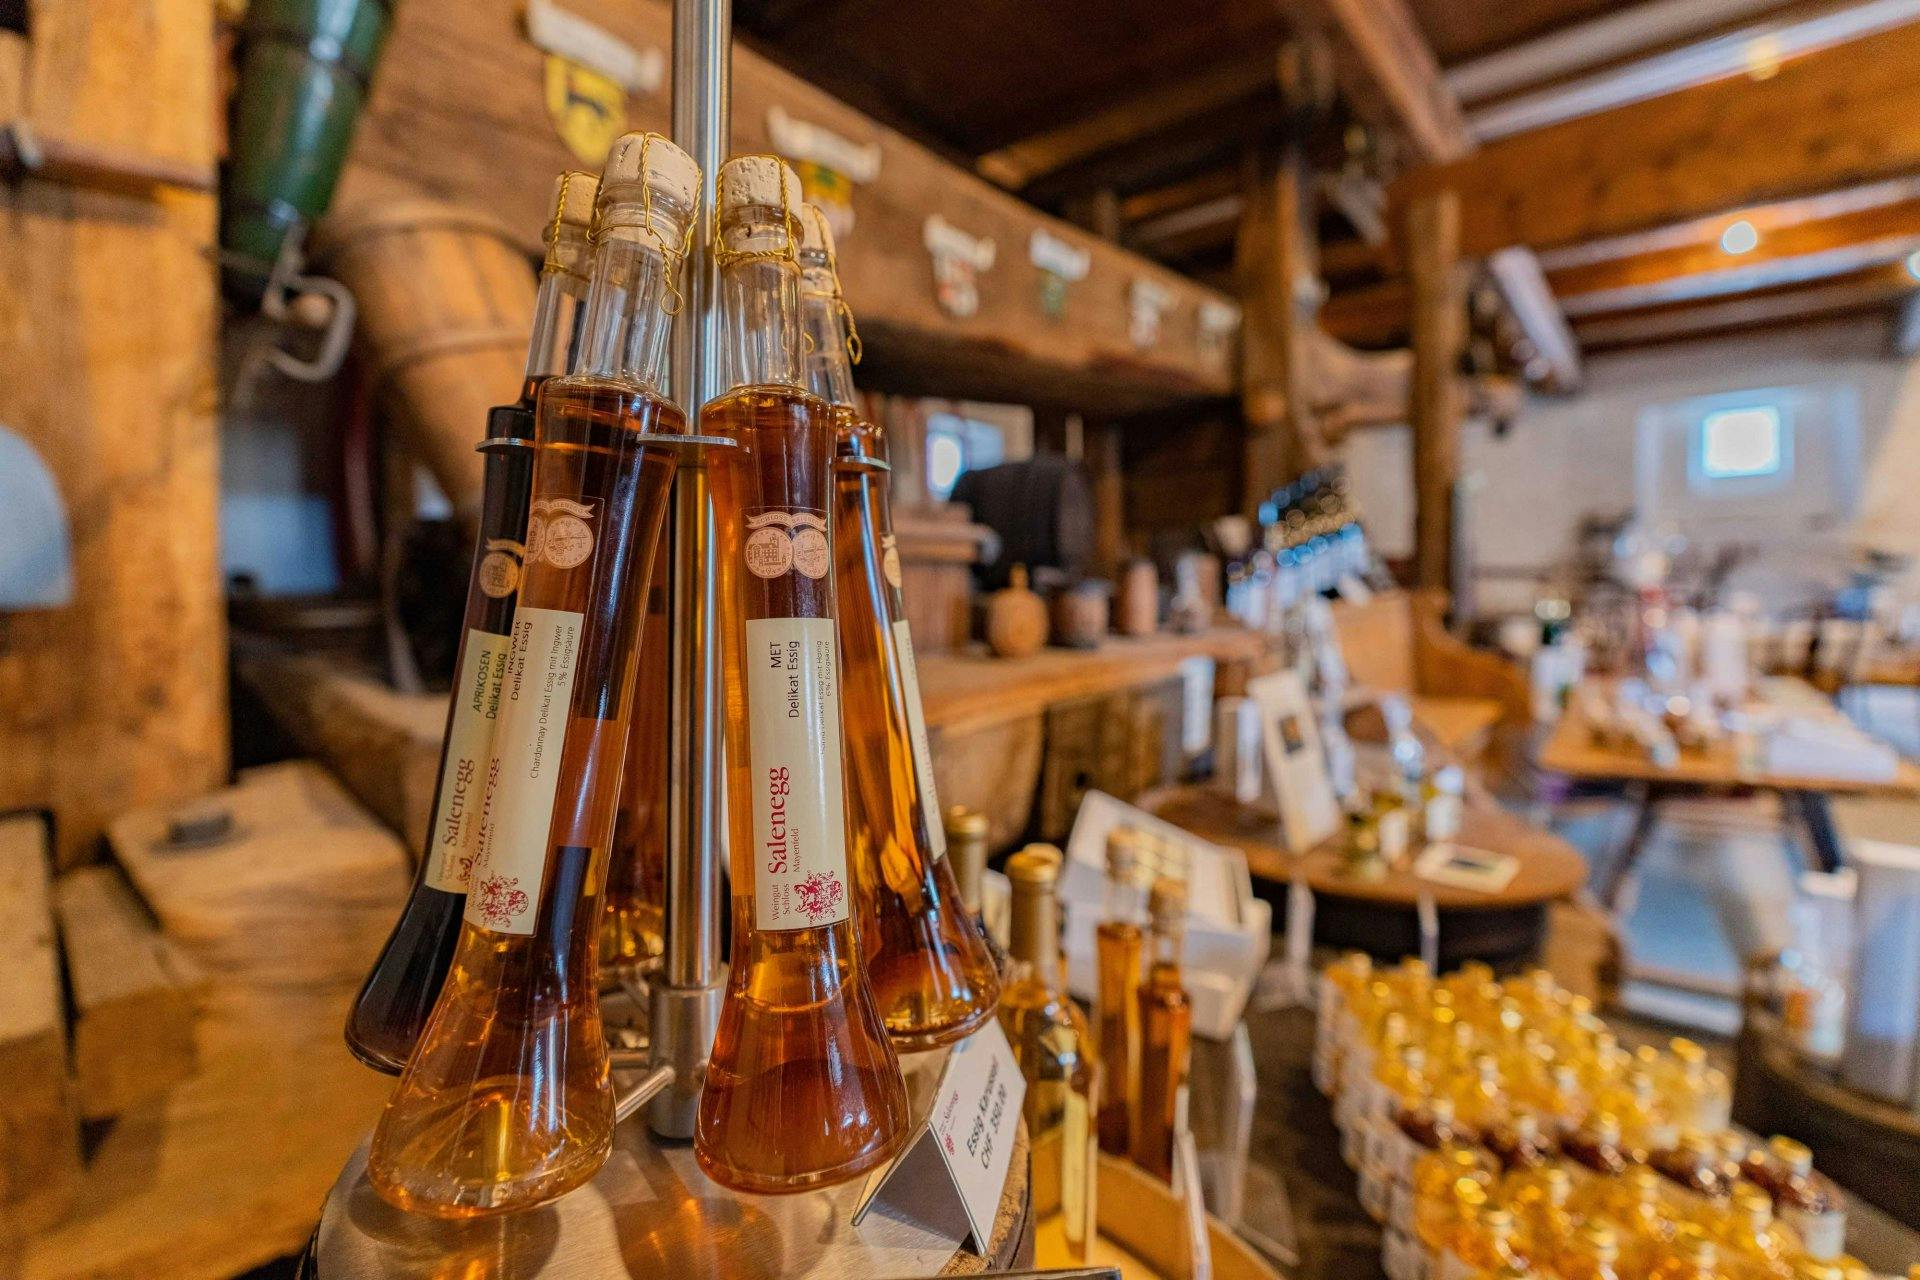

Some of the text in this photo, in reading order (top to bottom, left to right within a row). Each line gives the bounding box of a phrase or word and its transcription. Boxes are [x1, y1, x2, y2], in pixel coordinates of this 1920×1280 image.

[508, 620, 521, 674] INGWER
[511, 621, 533, 701] Delikat Essig
[769, 642, 782, 668] MET
[472, 650, 491, 712] APRIKOSEN
[486, 652, 507, 720] Delikat Essig
[530, 625, 563, 779] Chardonnay Delikat Essig mit Ingwer
[558, 672, 568, 687] 5%
[786, 641, 800, 718] Delikat Essig
[443, 758, 475, 847] Salenegg
[474, 757, 500, 866] Salenegg
[766, 766, 790, 874] Salenegg
[791, 828, 802, 873] Mayenfeld
[772, 884, 781, 921] Weingut
[967, 1115, 984, 1157] Essig
[981, 1132, 993, 1170] CHF
